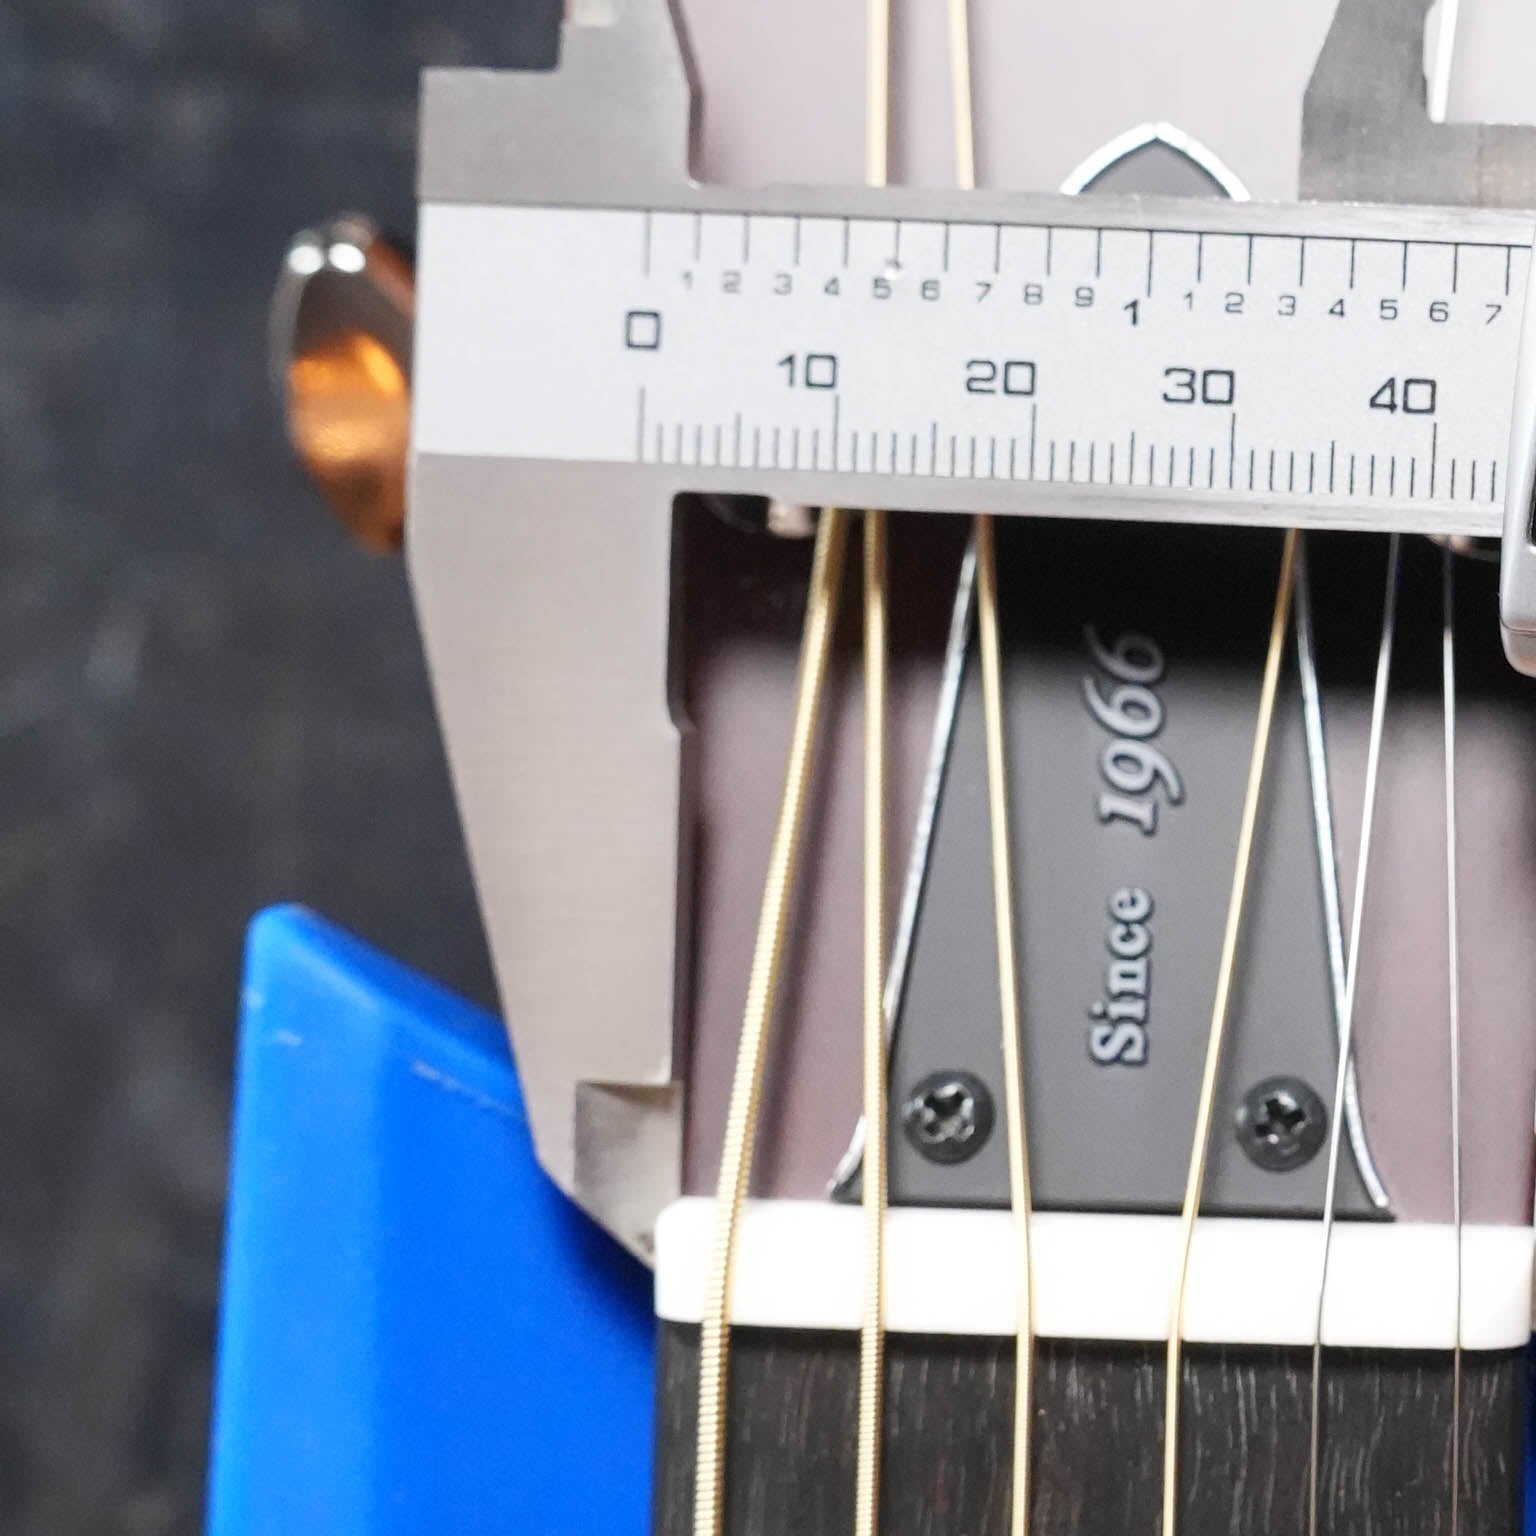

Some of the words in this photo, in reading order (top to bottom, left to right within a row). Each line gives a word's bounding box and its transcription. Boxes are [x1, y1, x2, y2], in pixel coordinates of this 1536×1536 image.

[626, 311, 660, 350] 0
[779, 354, 837, 389] 10
[966, 360, 1036, 396] 20
[1163, 367, 1235, 405] 30
[1370, 377, 1437, 414] 40
[723, 271, 741, 293] 2
[773, 273, 792, 295] 3
[824, 277, 839, 296] 4
[872, 278, 891, 299] 5
[921, 280, 939, 301] 6
[977, 282, 991, 301] 7
[1024, 284, 1042, 304] 8
[1075, 286, 1094, 307] 9
[1124, 300, 1138, 325] 1
[1185, 292, 1193, 309] 1
[1225, 292, 1244, 314] 2
[1278, 295, 1296, 316] 3
[1329, 299, 1345, 317] 4
[1380, 299, 1398, 320] 5
[1429, 302, 1448, 322] 6
[1486, 304, 1502, 324] 7
[1083, 623, 1184, 836] 1966
[1090, 885, 1154, 1067] Since
